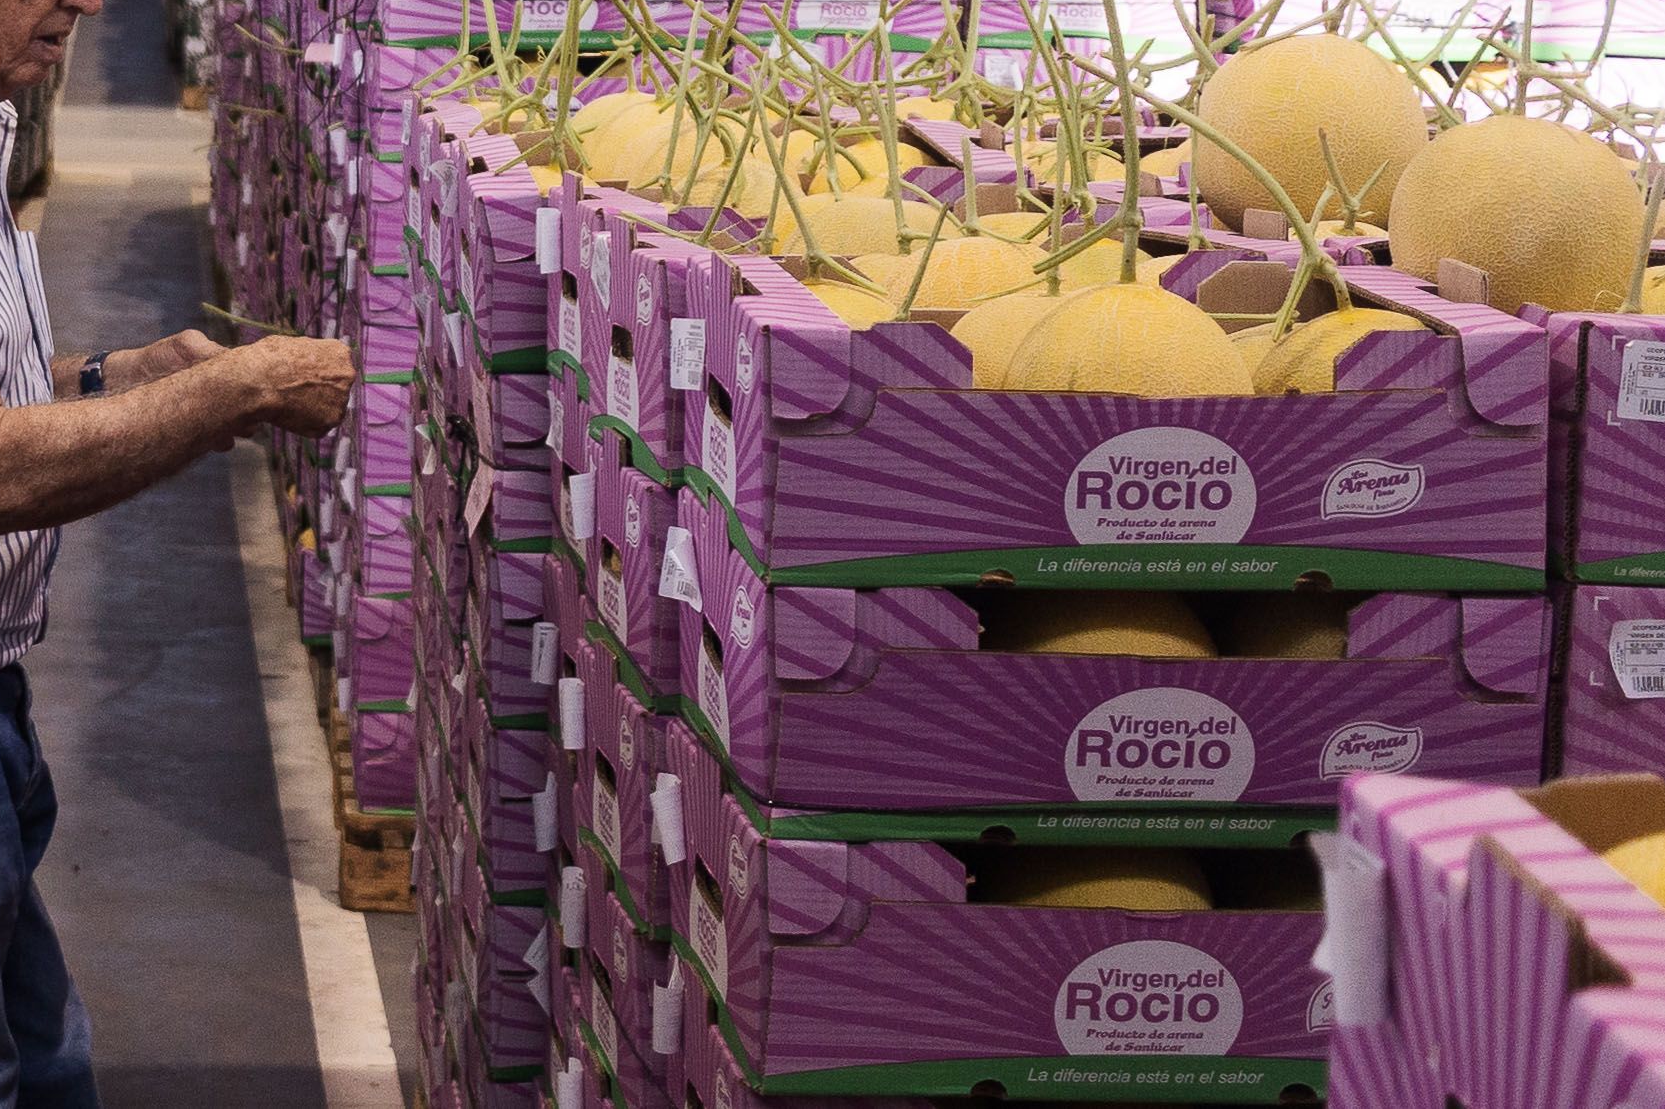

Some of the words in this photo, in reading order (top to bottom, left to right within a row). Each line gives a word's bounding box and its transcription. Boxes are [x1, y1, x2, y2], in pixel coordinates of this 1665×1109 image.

[1108, 456, 1191, 479] Virgen
[1199, 456, 1237, 475] del
[1336, 472, 1410, 495] Arenas
[1096, 517, 1157, 527] Producto
[1160, 517, 1175, 527] de
[1178, 519, 1216, 527] arena
[1116, 531, 1132, 540] de
[1135, 530, 1196, 541] Sanlúcar
[1037, 558, 1057, 572] La
[1063, 558, 1141, 572] diferencia
[1146, 558, 1181, 572] está
[1186, 562, 1206, 572] en
[1211, 558, 1226, 572] el
[1231, 558, 1278, 572] sabor
[1109, 715, 1190, 738] Virgen
[1198, 716, 1236, 735] del
[1335, 735, 1408, 757] Arenas
[1096, 775, 1156, 785] Producto
[1159, 775, 1174, 785] de
[1177, 778, 1215, 786] arena
[1115, 788, 1131, 797] de
[1133, 788, 1195, 798] Sanlúcar
[1037, 815, 1056, 827] La
[1062, 815, 1140, 828] diferencia
[1146, 816, 1179, 829] está
[1185, 819, 1204, 830] en
[1209, 816, 1223, 830] el
[1229, 816, 1277, 830] sabor
[1098, 968, 1177, 991] Virgen
[1187, 969, 1224, 988] del
[1086, 1029, 1145, 1039] Producto
[1148, 1029, 1164, 1039] de
[1167, 1031, 1203, 1039] arena
[1105, 1042, 1121, 1052] de
[1124, 1041, 1184, 1052] Sanlúcar
[1028, 1068, 1049, 1082] La
[1053, 1068, 1131, 1083] diferencia
[1136, 1069, 1169, 1083] está
[1175, 1073, 1194, 1083] en
[1200, 1070, 1214, 1083] el
[1218, 1070, 1264, 1084] sabor
